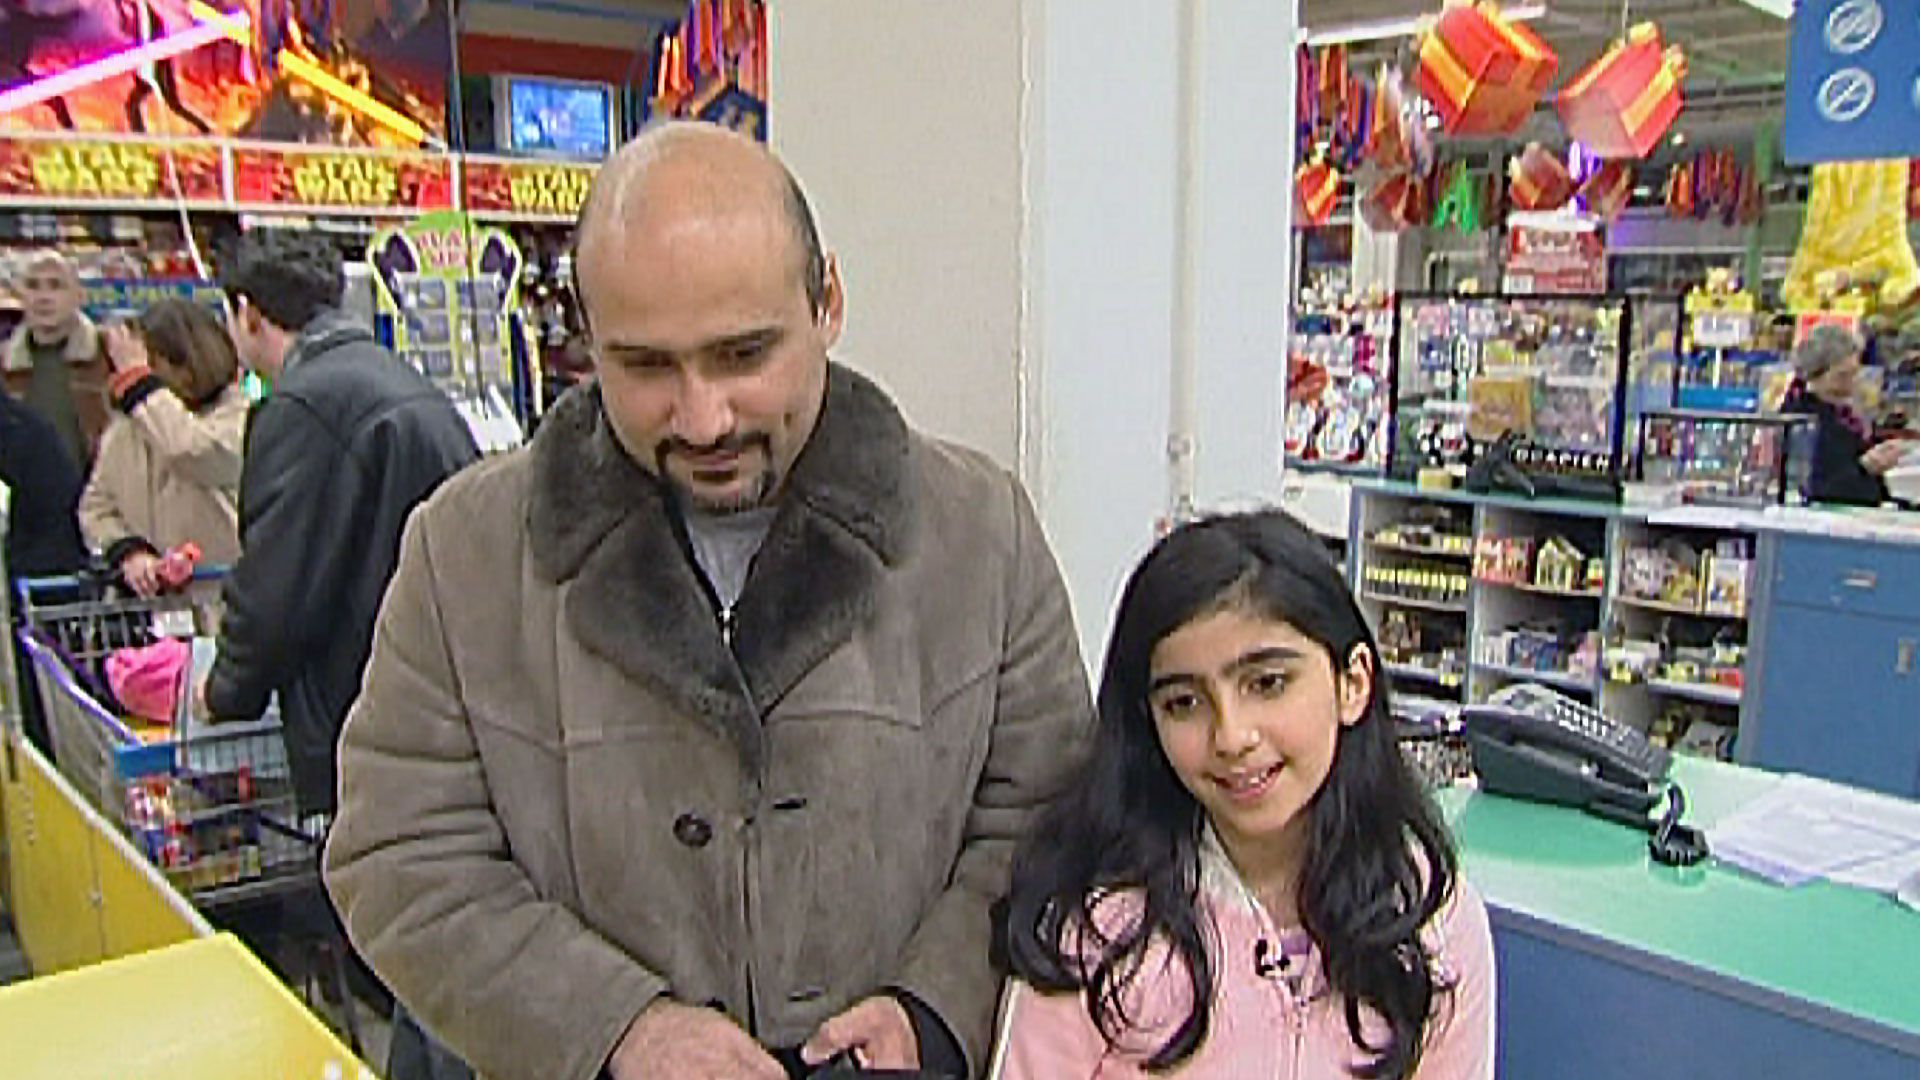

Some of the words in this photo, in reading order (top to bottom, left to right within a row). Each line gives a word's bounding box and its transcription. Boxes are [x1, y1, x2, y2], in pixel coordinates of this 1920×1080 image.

[34, 142, 155, 172] STAR
[295, 155, 395, 182] STAR
[36, 165, 148, 196] WARS
[297, 177, 390, 204] WARS
